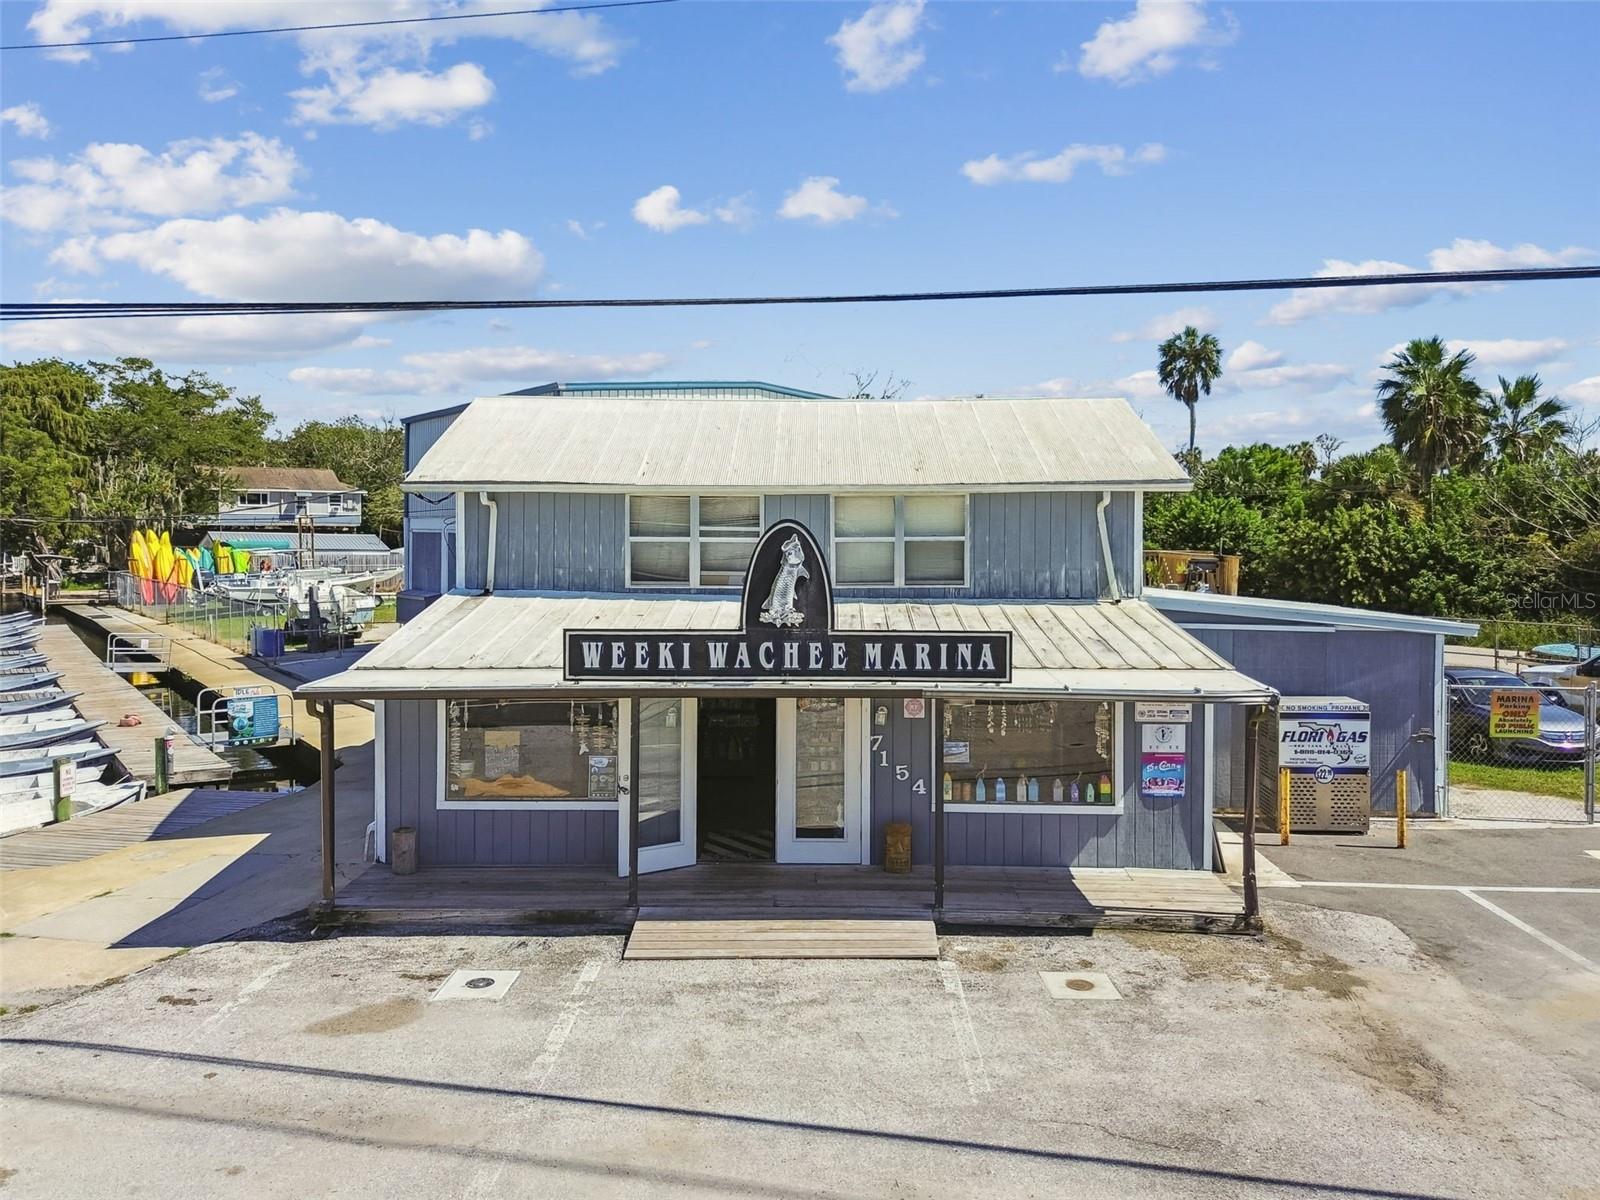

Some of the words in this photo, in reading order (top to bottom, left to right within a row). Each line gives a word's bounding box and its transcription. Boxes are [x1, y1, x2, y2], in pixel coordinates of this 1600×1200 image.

[582, 642, 690, 669] WEEKI
[707, 642, 848, 669] WACHEE
[864, 643, 996, 670] MARINA
[1496, 695, 1534, 703] MARINA
[1500, 703, 1531, 711] Parking
[1502, 710, 1528, 718] ONLY
[1281, 730, 1325, 743] FLORI
[1335, 731, 1369, 743] GAS
